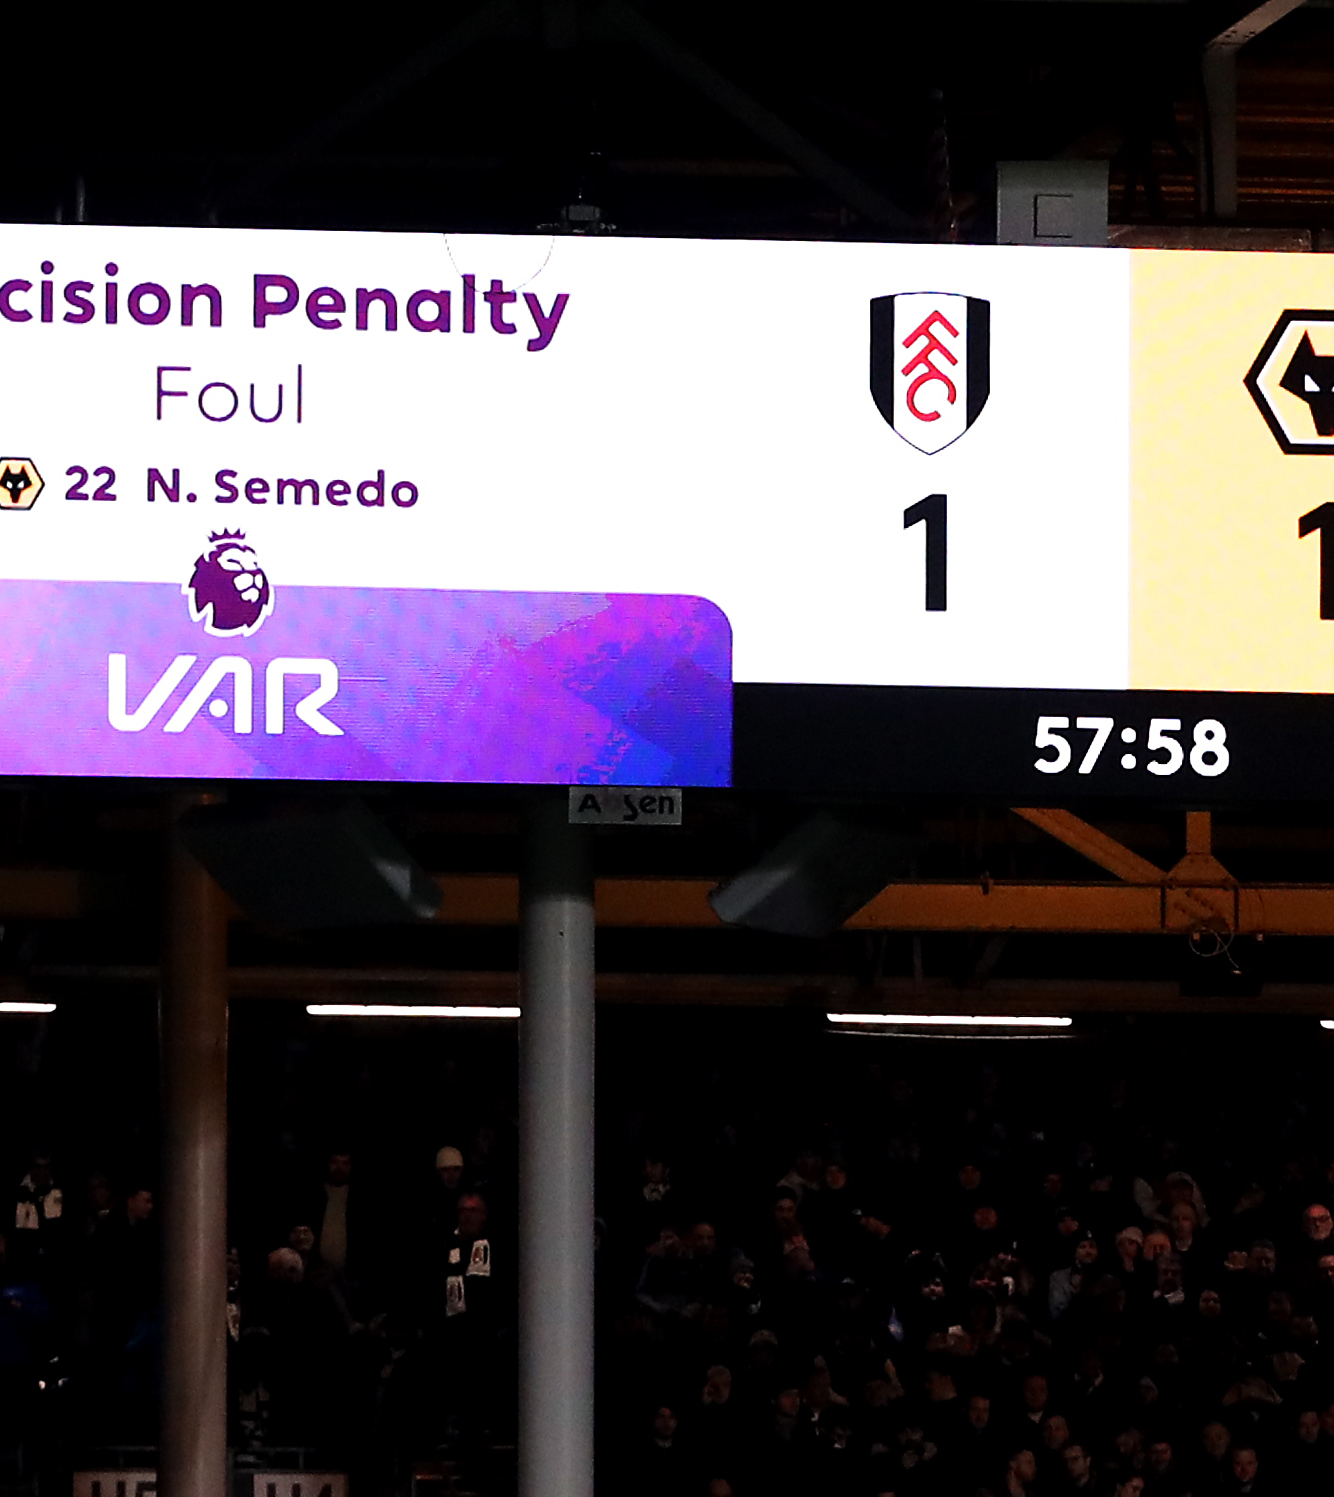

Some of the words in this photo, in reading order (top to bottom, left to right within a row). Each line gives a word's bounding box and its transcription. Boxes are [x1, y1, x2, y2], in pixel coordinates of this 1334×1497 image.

[252, 273, 570, 352] Penalty
[155, 363, 303, 424] Foul
[64, 465, 117, 503] 22
[145, 467, 198, 504] N.
[214, 467, 420, 510] Semedo
[903, 493, 948, 612] 1
[106, 652, 345, 736] VAR
[1033, 716, 1231, 777] 57:58
